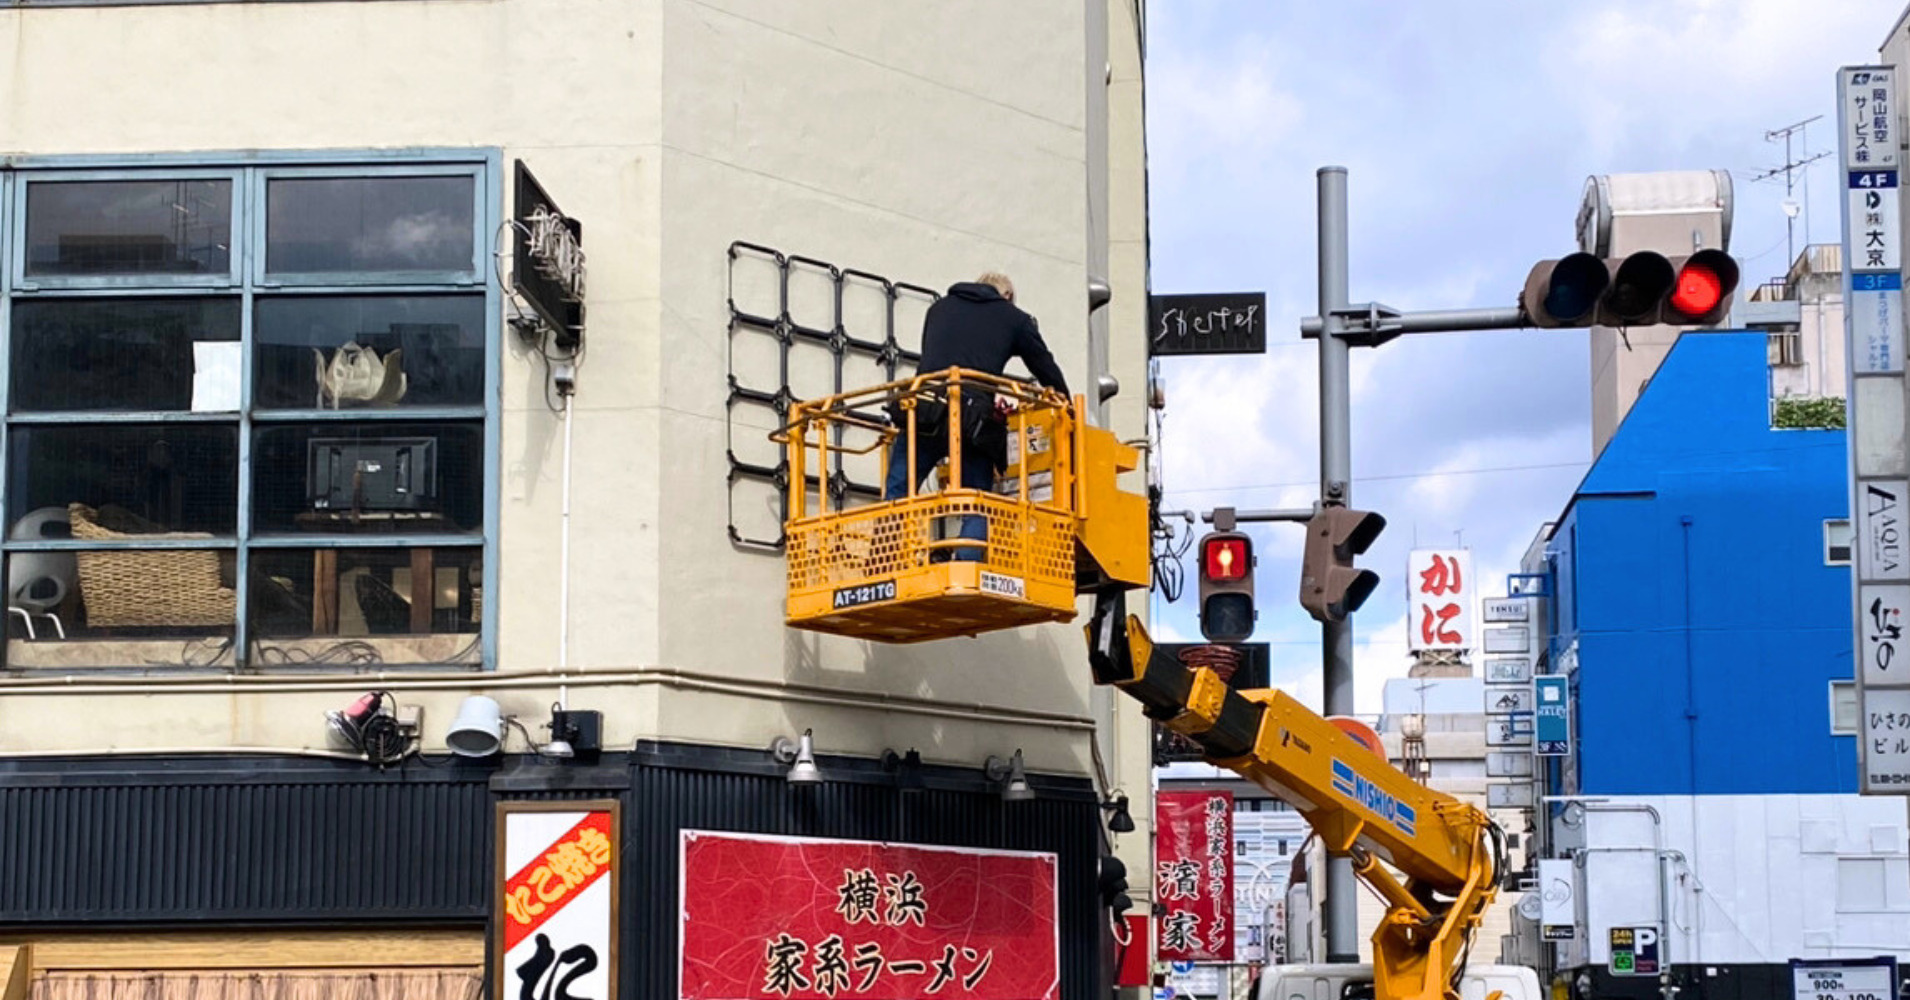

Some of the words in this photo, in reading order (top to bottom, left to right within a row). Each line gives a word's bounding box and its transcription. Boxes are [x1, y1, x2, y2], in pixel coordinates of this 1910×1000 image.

[1873, 88, 1889, 143] 岡山航空
[1859, 173, 1888, 187] 4F
[1865, 274, 1888, 289] 3F
[1881, 514, 1900, 572] AQUA
[834, 582, 895, 607] AT-121TG
[1419, 553, 1463, 645] かに
[1870, 712, 1910, 730] ひさの
[1874, 738, 1909, 755] ビル
[1355, 774, 1395, 821] NISHIO
[836, 868, 929, 927] 横浜
[1205, 797, 1229, 953] 横浜家系ラーメン
[761, 931, 993, 998] 家系ラーメン
[1635, 929, 1656, 955] P
